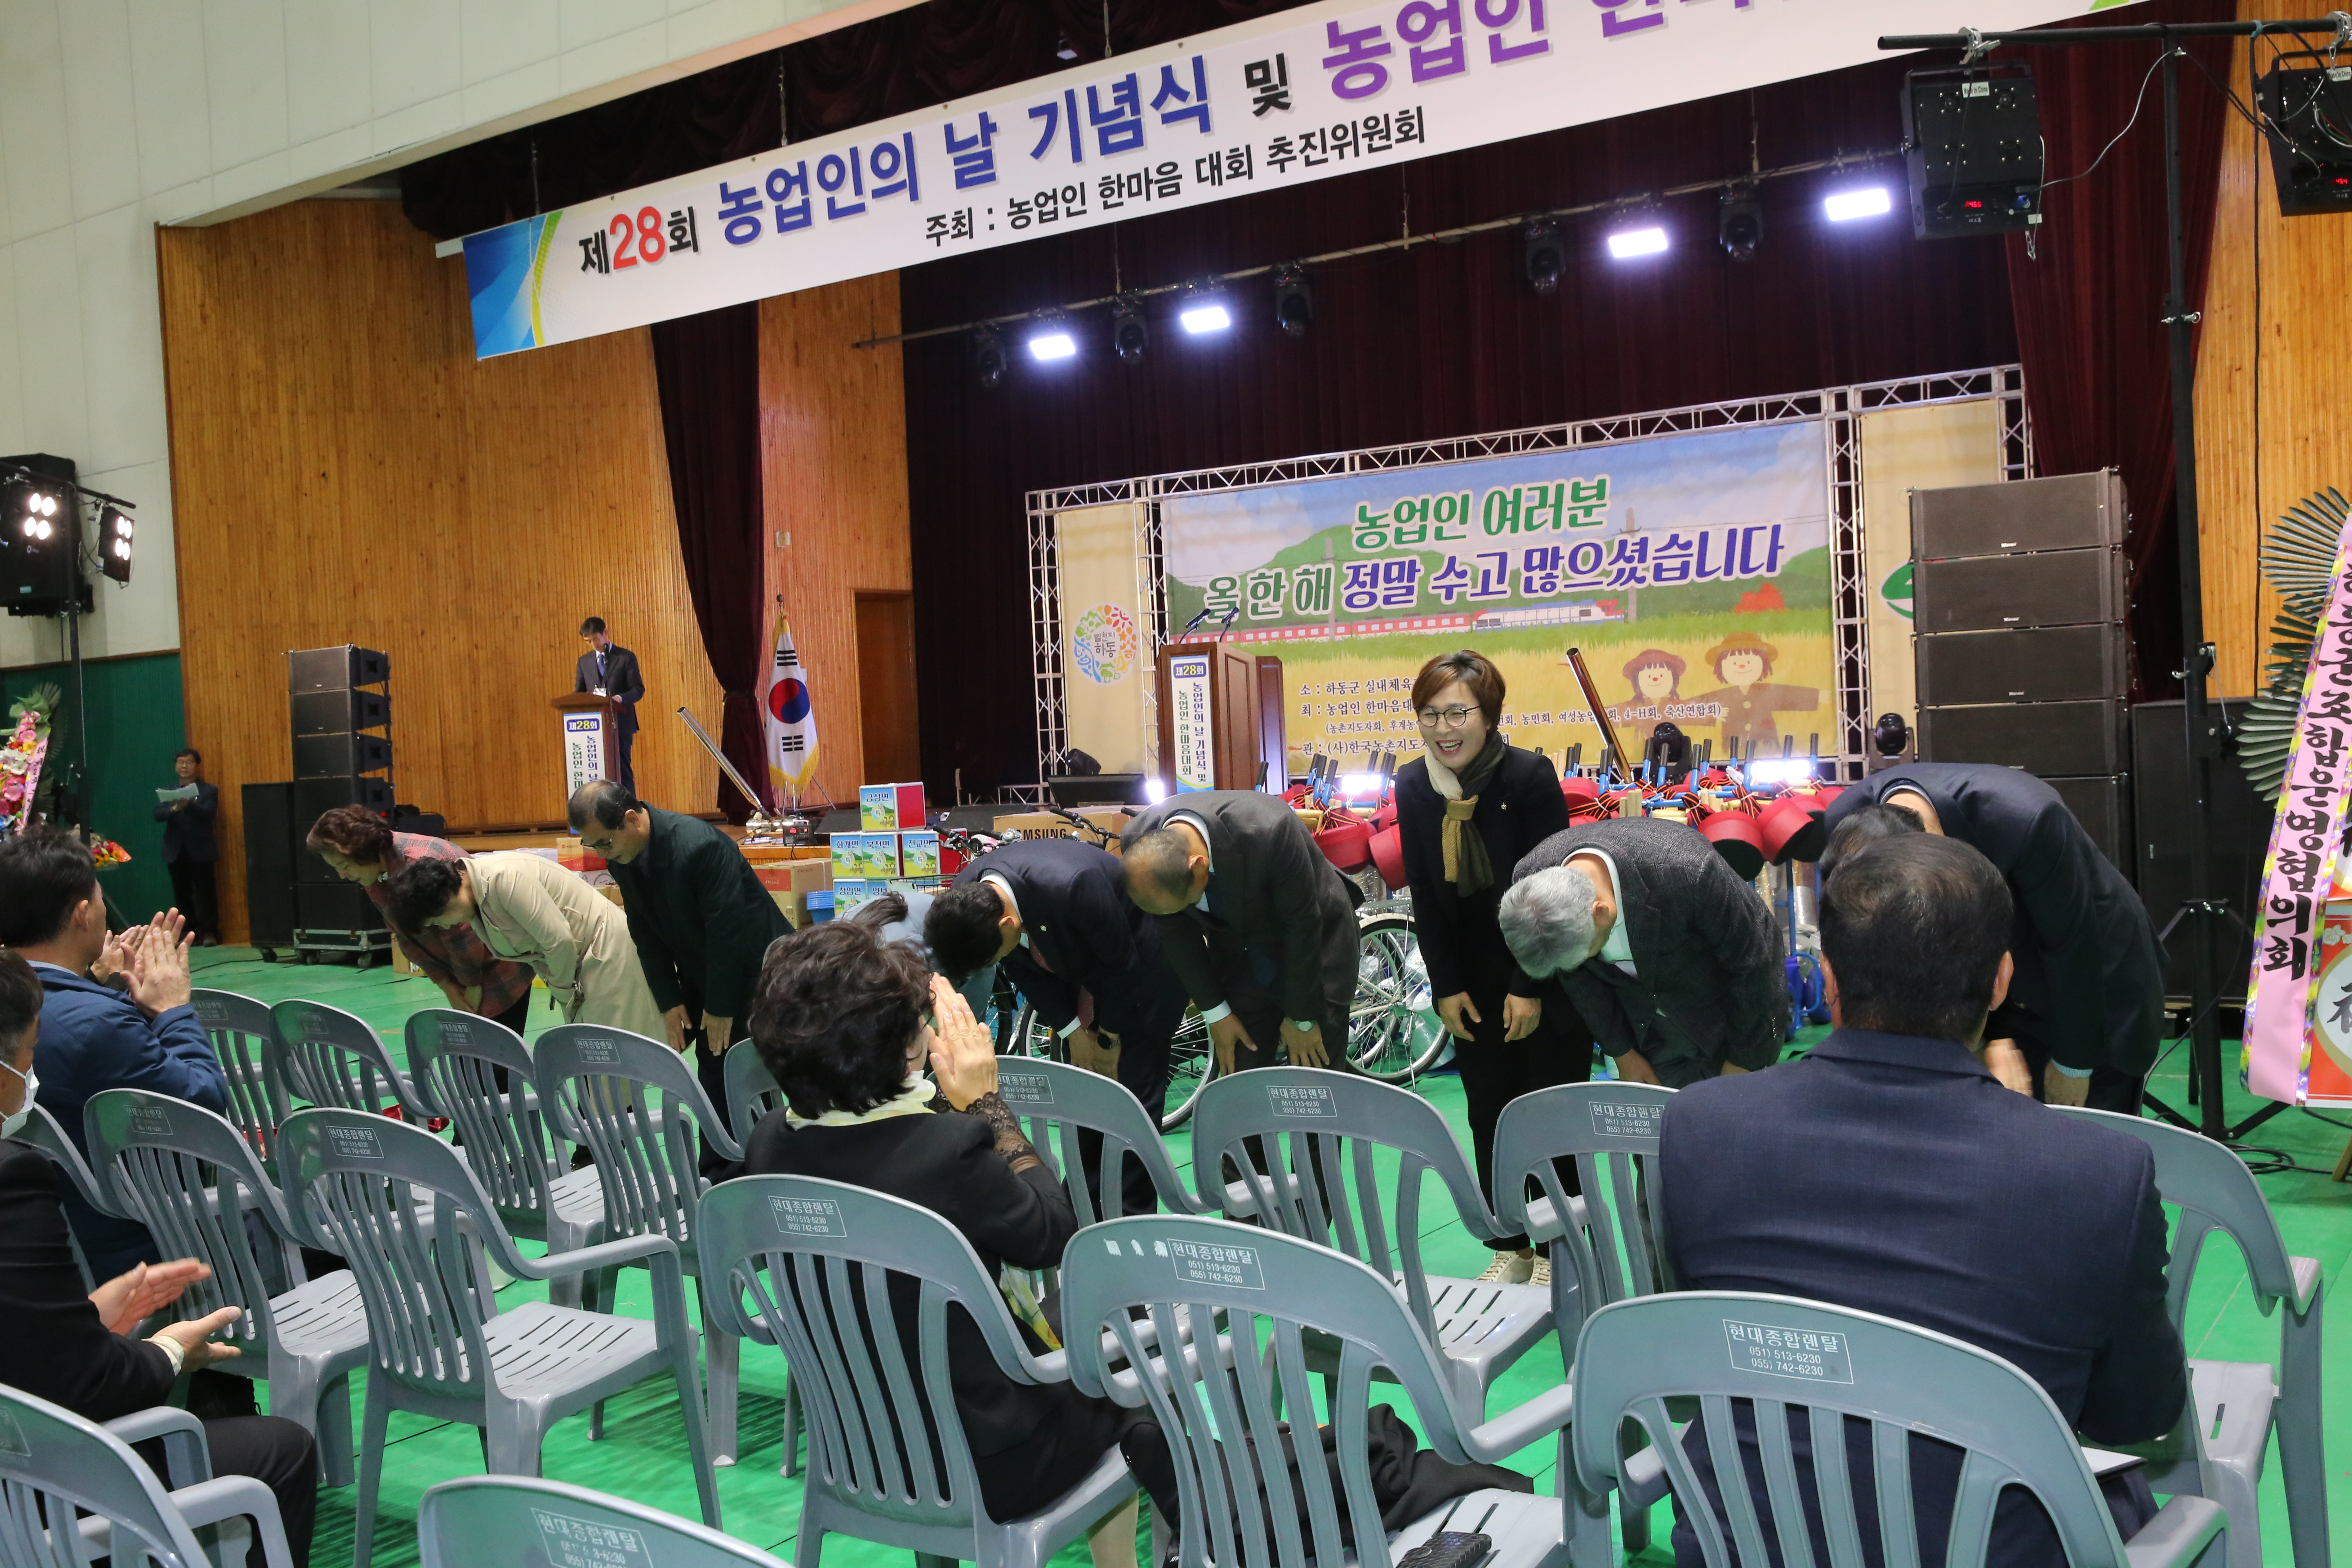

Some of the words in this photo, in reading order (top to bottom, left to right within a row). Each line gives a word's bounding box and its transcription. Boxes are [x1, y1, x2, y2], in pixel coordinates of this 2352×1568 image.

[579, 206, 698, 274] 제28회
[717, 132, 920, 245] 농업인의
[944, 111, 997, 189] 날
[1029, 55, 1211, 164] 기념식
[1245, 53, 1291, 117] 및
[1323, 0, 1548, 99] 농업인
[926, 212, 975, 247] 주최
[1007, 182, 1087, 229] 농업인
[1098, 162, 1182, 209] 한마음
[1196, 145, 1253, 186] 대회
[1267, 106, 1425, 174] 추진위원회
[1357, 493, 1469, 549] 농업인
[1483, 478, 1608, 535] 여러분
[1344, 559, 1421, 609] 정말
[1431, 552, 1508, 600] 수고
[1524, 524, 1784, 594] 많으셨습니다
[1175, 664, 1204, 677] 제28회
[1300, 684, 1312, 695] 소
[1325, 681, 1361, 696] 하동군
[1365, 677, 1417, 693] 실내체육
[1178, 690, 1189, 721] 농업인
[1193, 682, 1204, 723] 농업인의
[1301, 704, 1311, 717] 최
[1326, 701, 1361, 716] 농업인
[1365, 698, 1414, 713] 한마음대
[569, 720, 597, 730] 제28회
[1326, 720, 1385, 735] (농촌지도자회,
[1389, 719, 1420, 731] 후계농
[1521, 712, 1554, 726] 농민회,
[1559, 708, 1620, 724] 여성농업회,
[1624, 706, 1661, 719] 4-H회,
[1665, 702, 1722, 717] 축산연합회)
[1194, 727, 1205, 736] 날
[572, 743, 583, 768] 농업인
[587, 735, 597, 770] 농업인의
[1180, 724, 1192, 775] 한마음대회
[1195, 739, 1206, 770] 기념식
[1303, 742, 1314, 756] 관
[574, 772, 583, 788] 한마
[866, 793, 889, 802] 금성면
[1016, 829, 1067, 840] MSUNG
[836, 840, 858, 849] 화개면
[867, 840, 889, 849] 북천면
[908, 839, 931, 848] 진교면
[839, 887, 861, 895] 청암면
[873, 886, 888, 895] 양보
[1270, 1088, 1327, 1099] 현대종합렌탈
[1592, 1104, 1660, 1118] 현대종합렌탈
[329, 1128, 374, 1140] 현대종합렌탈
[772, 1199, 835, 1214] 현대종합렌탈
[800, 1216, 826, 1224] 513-6230
[788, 1223, 800, 1231] 055)
[802, 1224, 829, 1233] 742-6230
[1172, 1242, 1252, 1265] 현대종합렌탈
[1187, 1260, 1204, 1270] 051)
[1206, 1262, 1241, 1274] 513-6230
[1190, 1270, 1206, 1280] 055)
[1207, 1272, 1243, 1284] 742-6230
[1729, 1324, 1838, 1352] 현대종합렌탈
[1749, 1346, 1771, 1358] 051)
[1774, 1350, 1821, 1364] 513-6230
[1751, 1357, 1773, 1370] 055)
[1776, 1361, 1823, 1376] 742-6230
[538, 1513, 639, 1552] 현대종합렌탈
